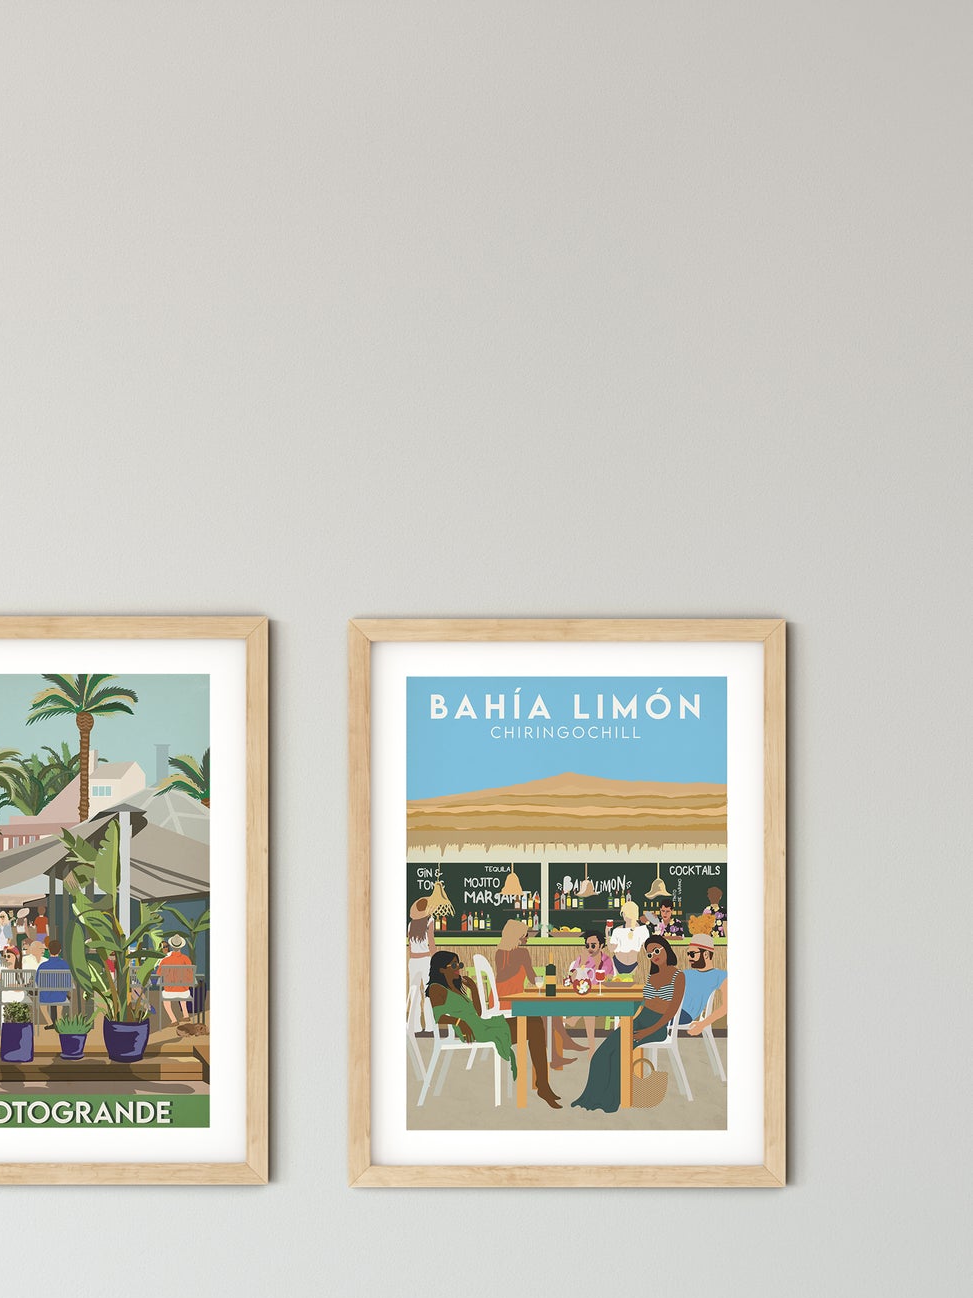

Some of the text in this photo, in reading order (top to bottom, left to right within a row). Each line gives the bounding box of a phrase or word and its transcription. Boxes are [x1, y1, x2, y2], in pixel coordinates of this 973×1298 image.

[430, 687, 701, 720] BAHÍA LIMÓN
[490, 726, 641, 739] CHIRINGOCHILL
[434, 868, 443, 877] &
[484, 865, 511, 873] TEQUILA
[669, 864, 721, 876] COCKTAILS
[416, 879, 445, 891] TONC
[463, 877, 501, 889] MOJITO
